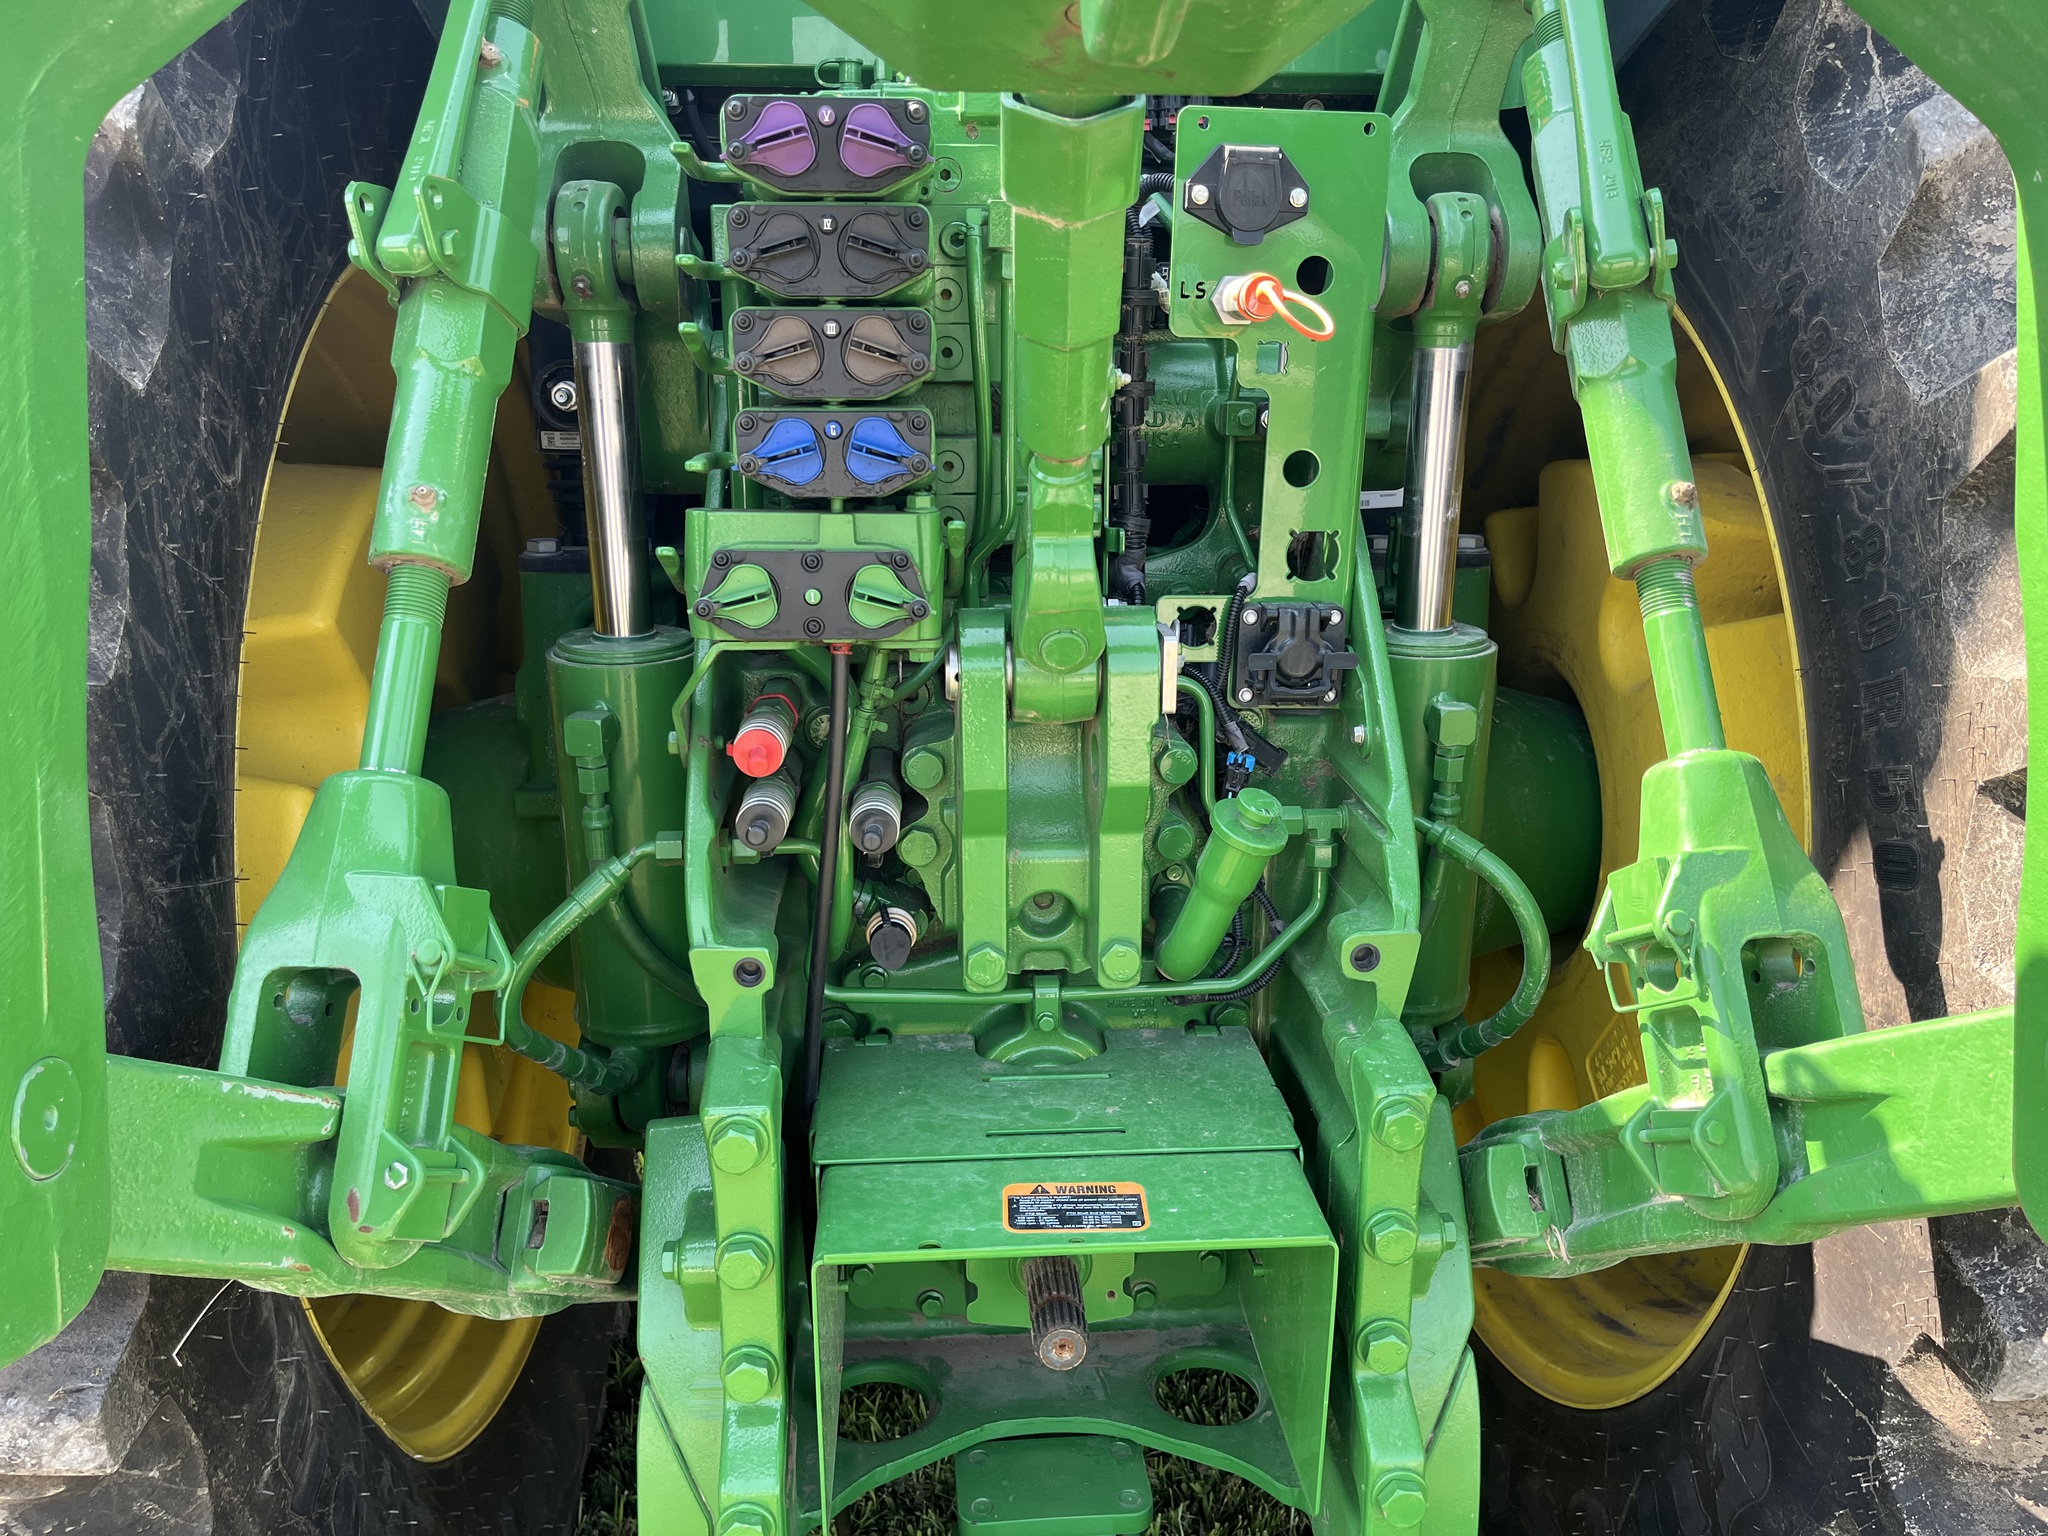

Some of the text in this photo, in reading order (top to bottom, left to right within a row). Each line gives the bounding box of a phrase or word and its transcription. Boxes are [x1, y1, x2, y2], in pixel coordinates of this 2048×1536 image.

[822, 110, 832, 122] V
[1232, 189, 1270, 207] Pollak
[823, 218, 833, 231] IV
[1180, 280, 1206, 300] LS
[827, 323, 836, 335] III
[1055, 1184, 1117, 1194] WARNING
